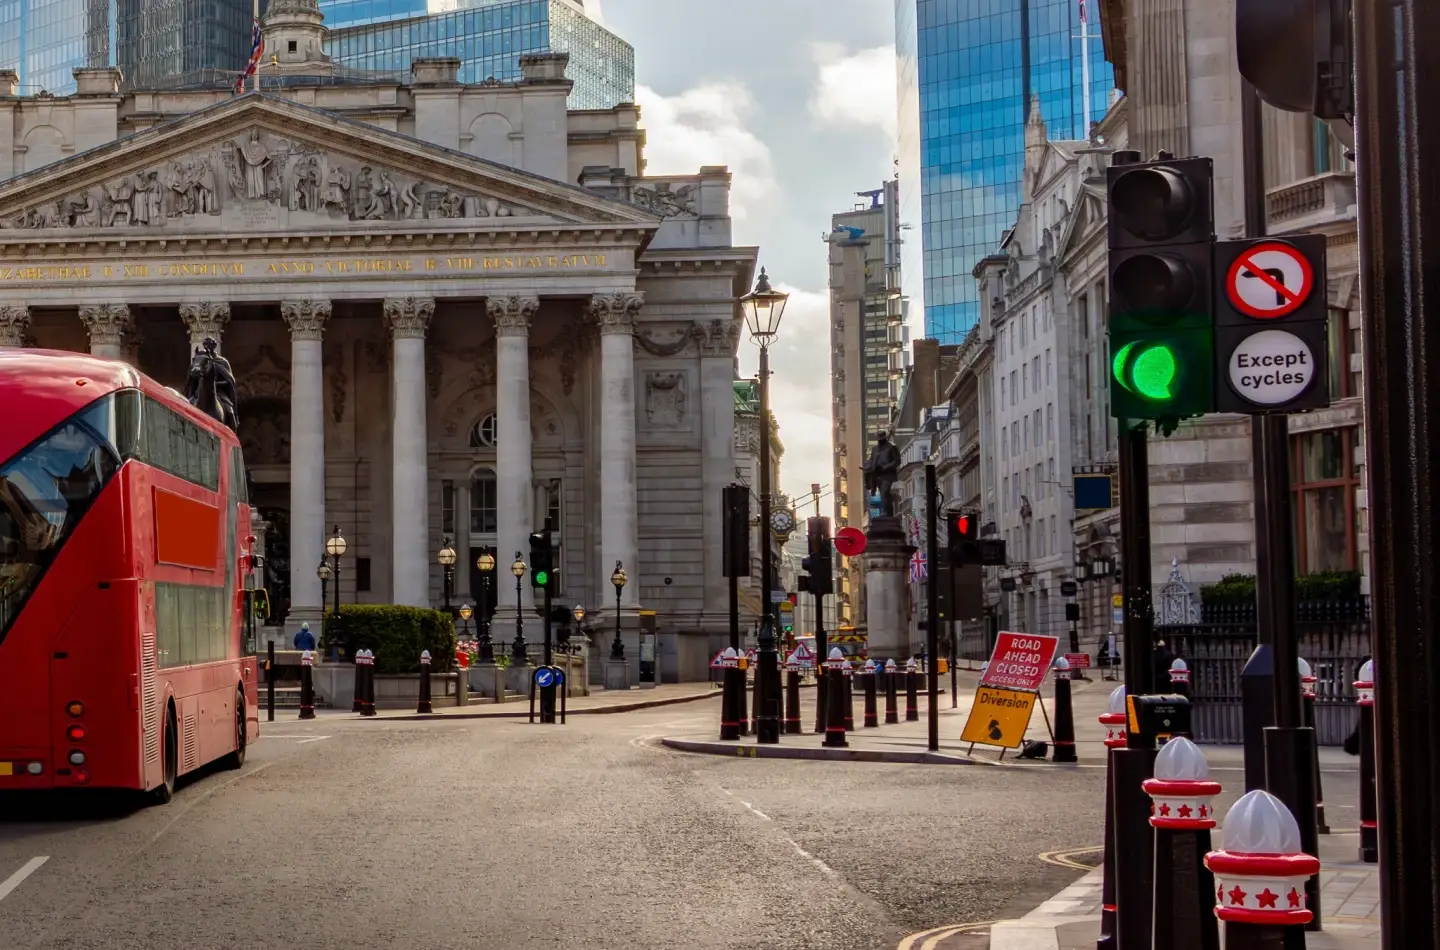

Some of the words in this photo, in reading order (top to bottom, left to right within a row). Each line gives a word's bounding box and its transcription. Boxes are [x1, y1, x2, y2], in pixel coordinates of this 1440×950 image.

[124, 264, 150, 277] XIII
[266, 260, 314, 274] ANNO
[325, 259, 412, 273] VICTORIAE
[425, 258, 436, 271] R
[447, 257, 472, 270] VIII
[482, 255, 607, 269] RESTAVRATVM
[1237, 350, 1306, 368] Except
[1241, 370, 1304, 389] cycles
[1011, 638, 1041, 651] ROAD
[1003, 650, 1041, 664] AHEAD
[996, 663, 1039, 677] CLOSED
[989, 675, 1016, 684] ACCESS
[1016, 678, 1035, 686] ONLY
[980, 692, 1029, 709] Diversion
